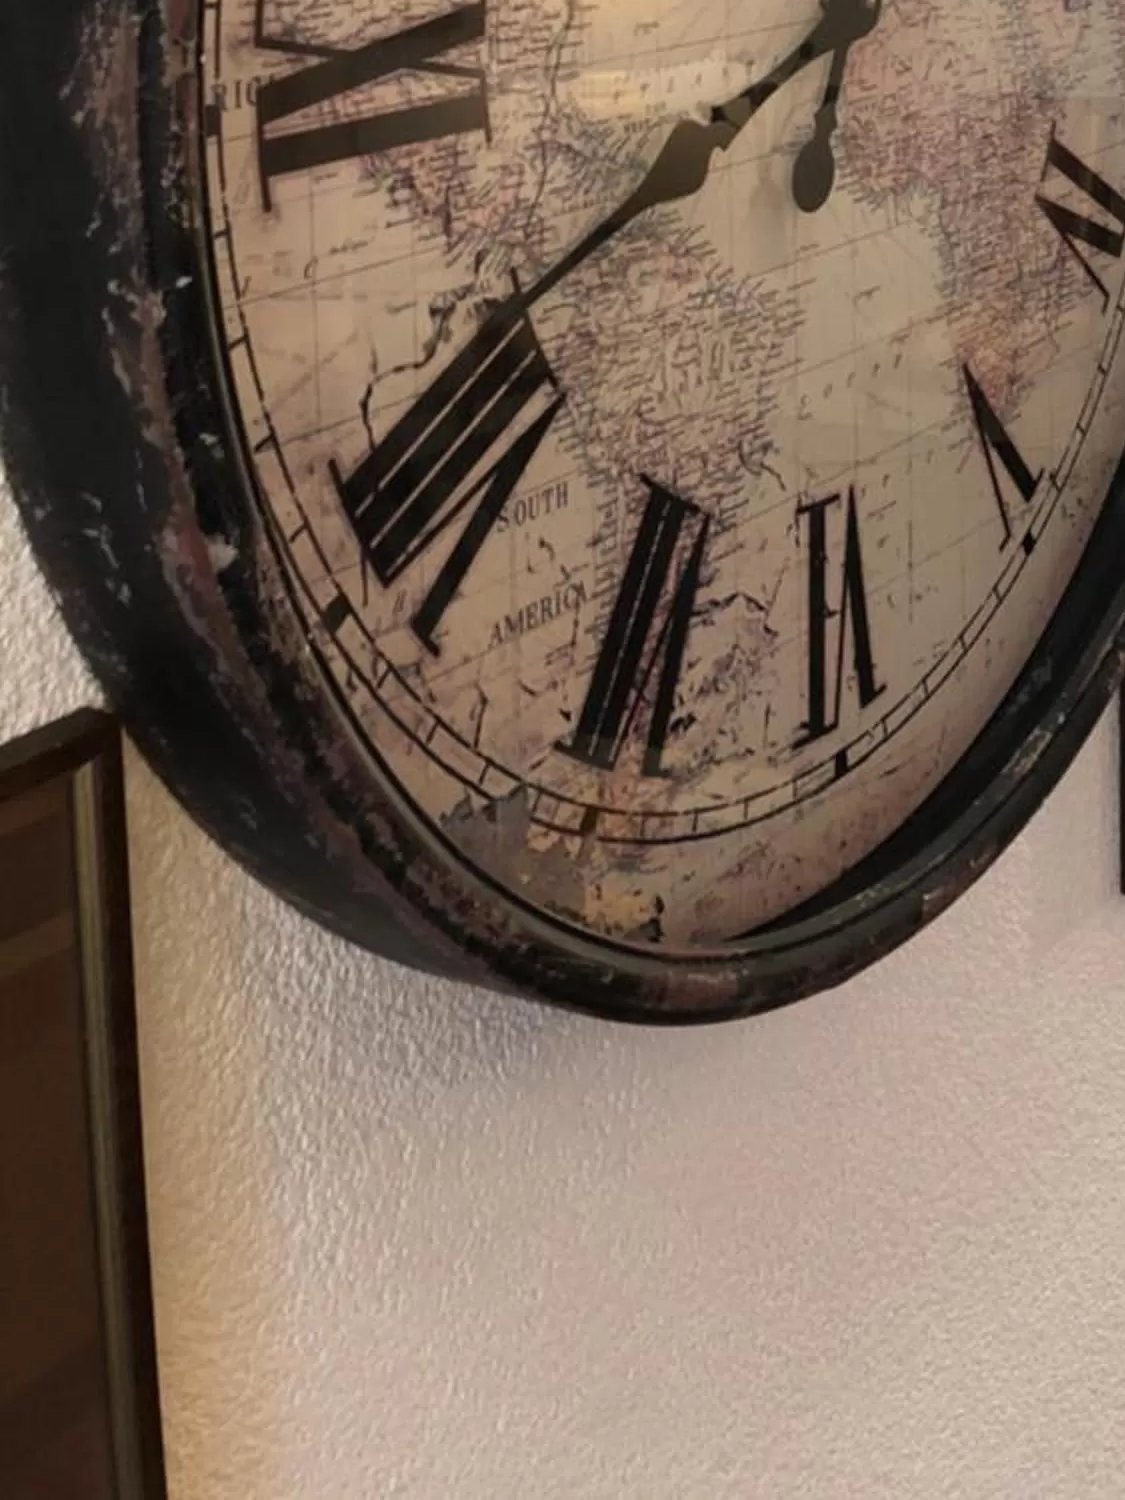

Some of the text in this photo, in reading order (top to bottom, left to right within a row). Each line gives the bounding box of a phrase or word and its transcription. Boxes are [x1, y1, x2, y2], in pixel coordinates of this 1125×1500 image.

[328, 266, 567, 658] VIII
[496, 482, 569, 533] SOUTH
[963, 361, 1045, 552] V
[488, 580, 588, 650] AMERICA
[553, 473, 711, 778] VII
[790, 483, 886, 750] VI
